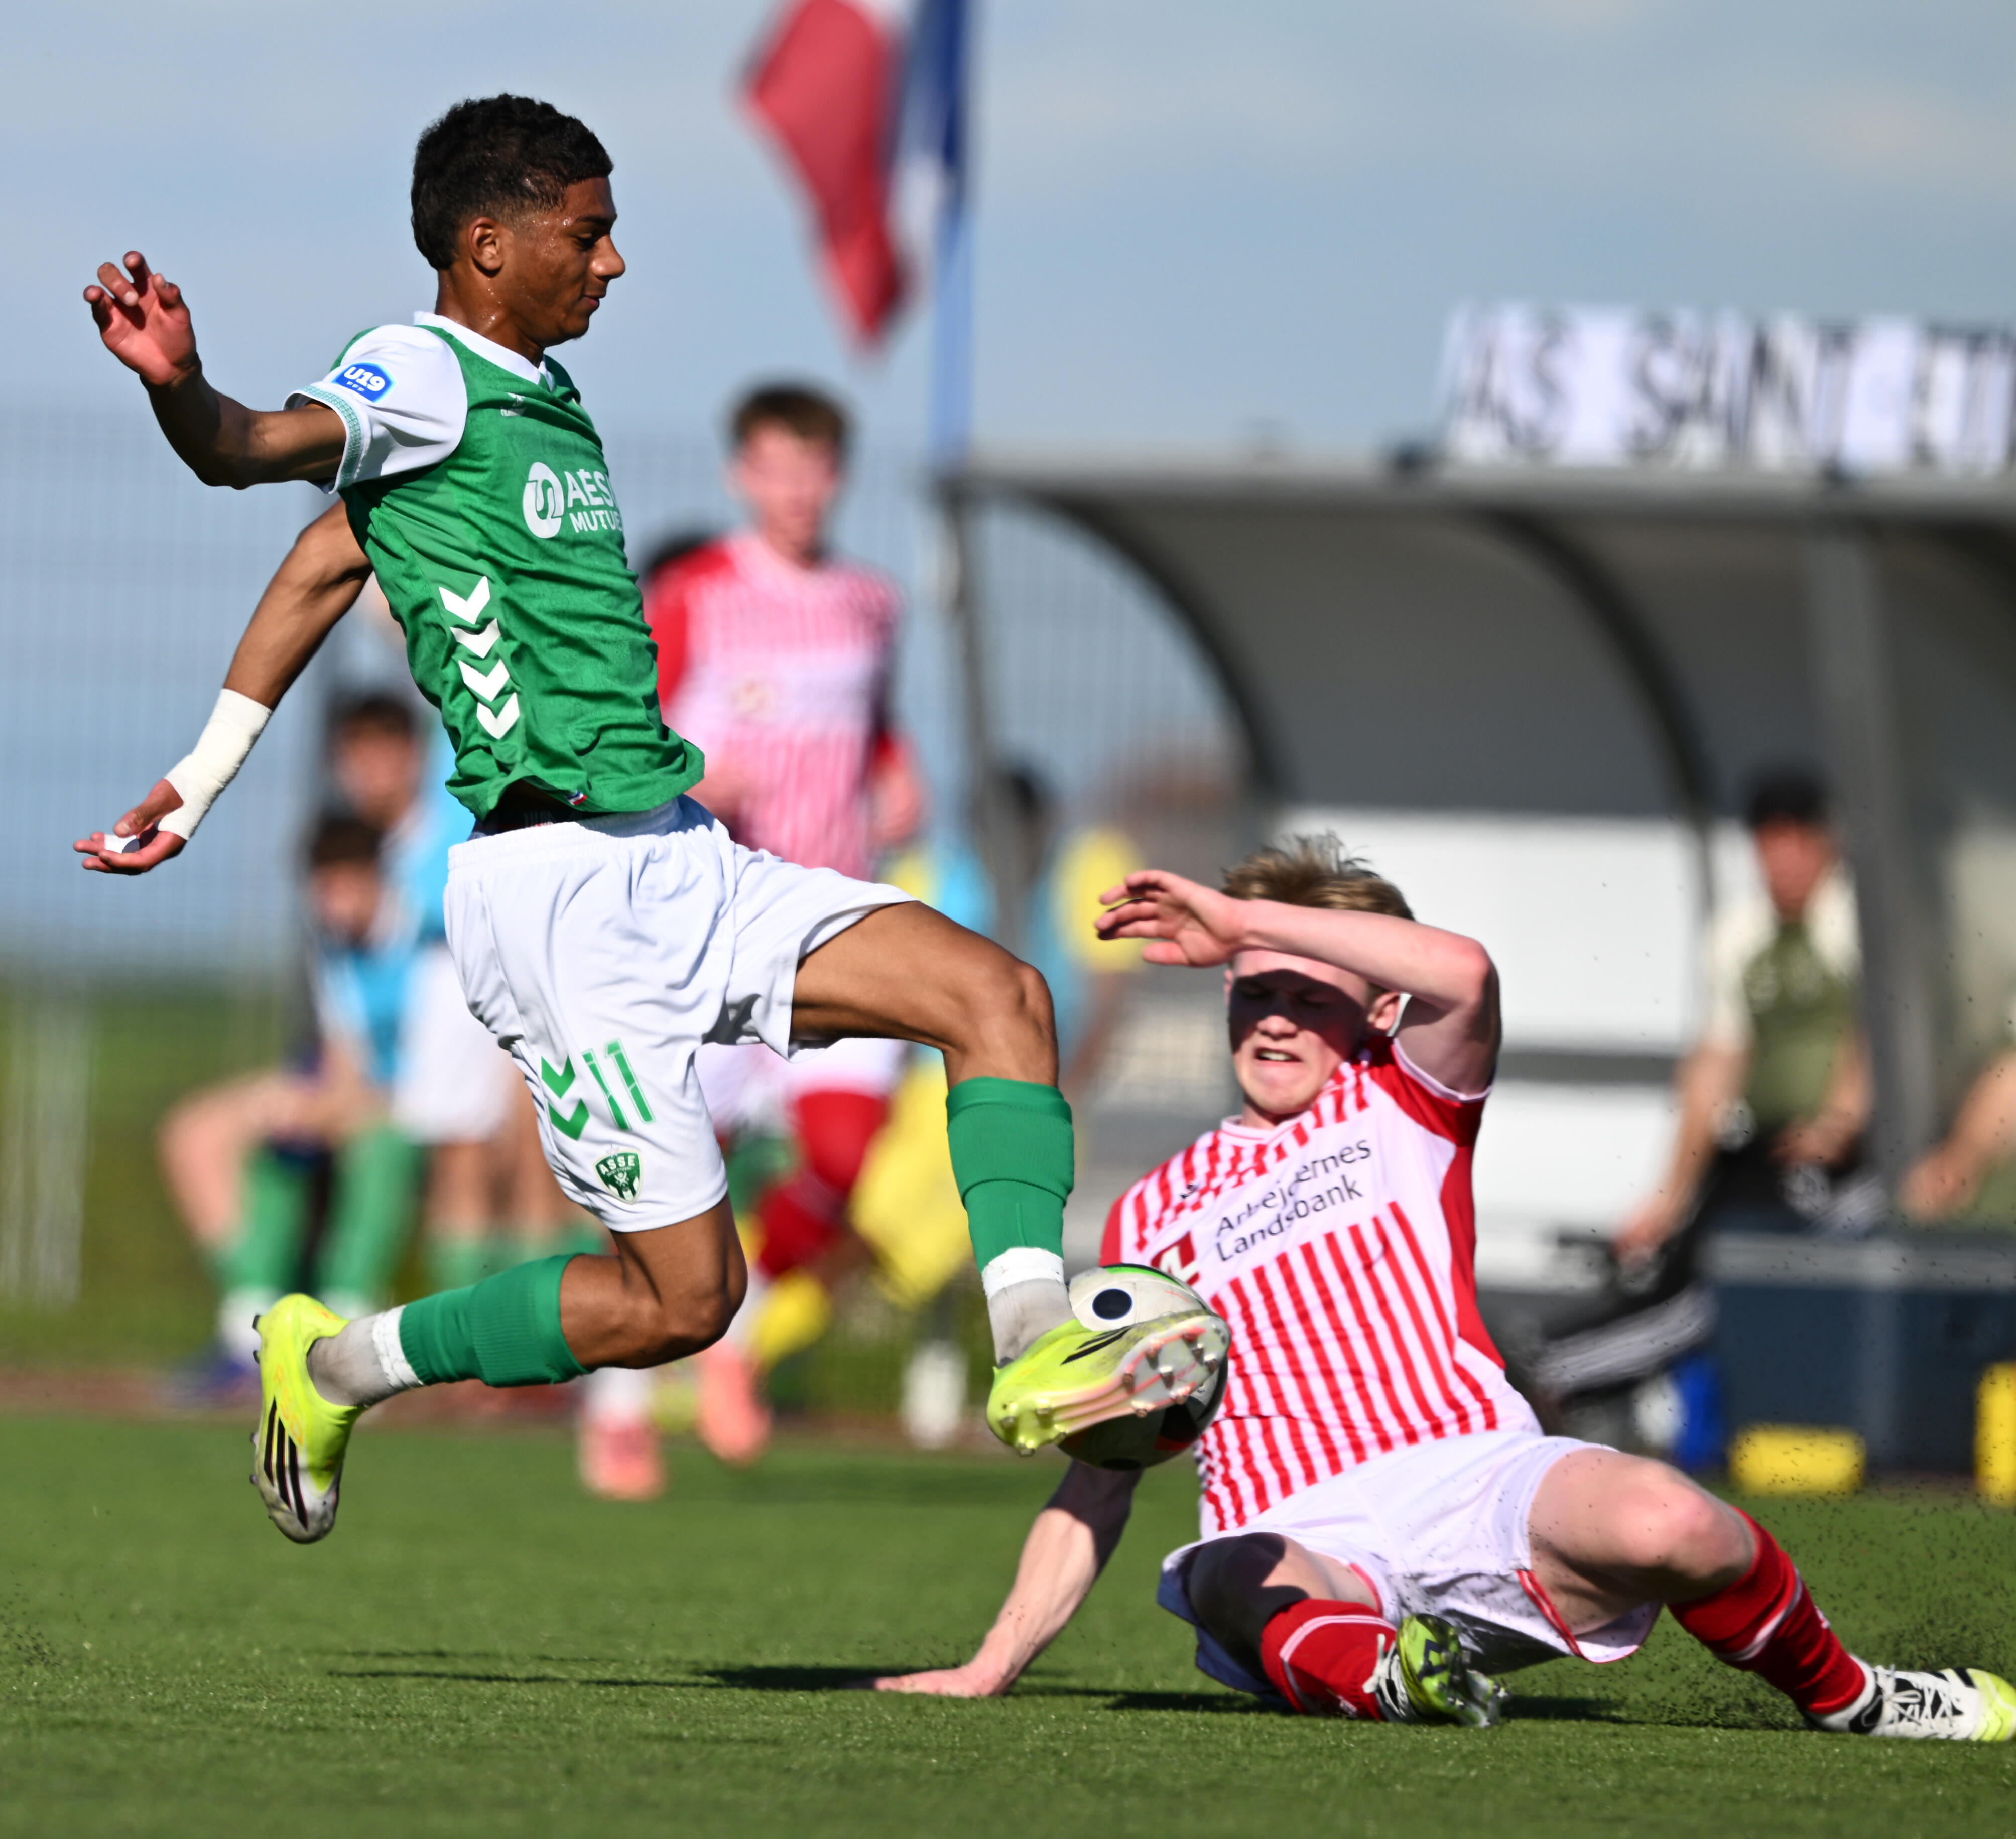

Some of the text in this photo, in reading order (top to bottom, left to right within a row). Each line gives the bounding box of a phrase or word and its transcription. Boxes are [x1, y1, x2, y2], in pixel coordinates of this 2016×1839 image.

[344, 366, 385, 391] U19
[346, 381, 365, 392] FFF
[581, 1038, 656, 1132] 11
[598, 1155, 636, 1175] ASSE
